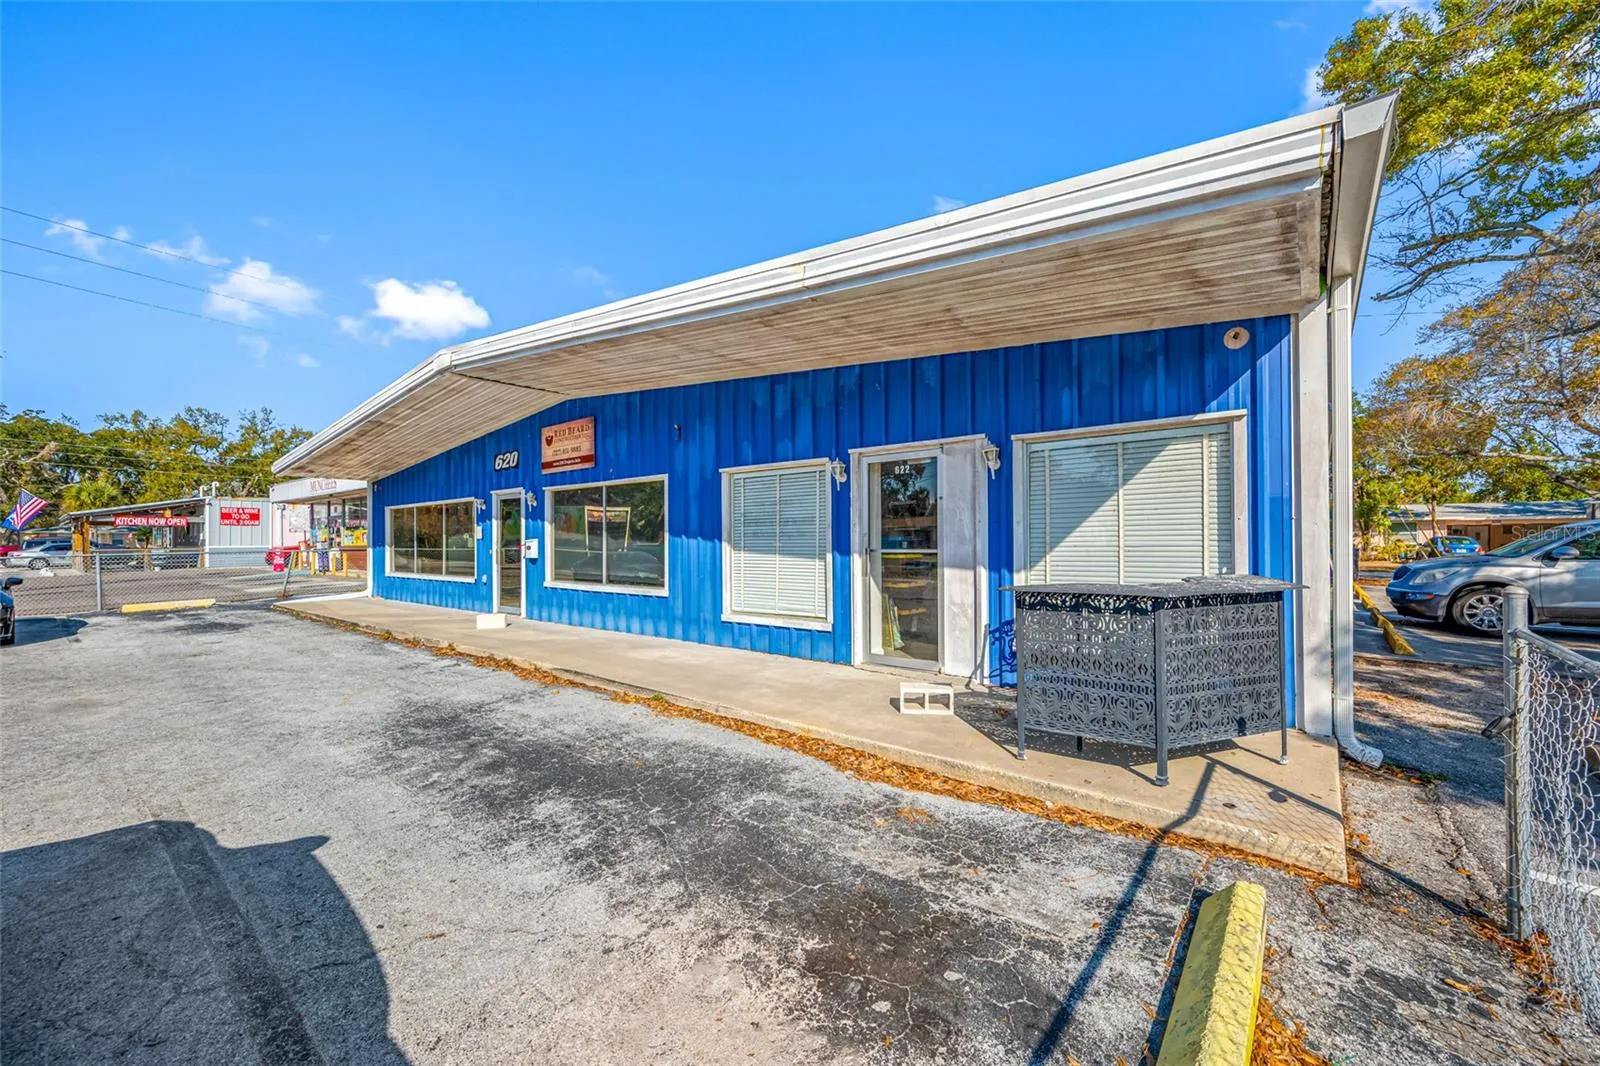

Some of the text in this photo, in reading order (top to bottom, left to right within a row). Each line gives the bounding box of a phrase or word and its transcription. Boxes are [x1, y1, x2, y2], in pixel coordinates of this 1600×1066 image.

[495, 451, 518, 470] 620
[894, 465, 910, 474] 622
[115, 517, 187, 526] KITCHEN NOW OPEN
